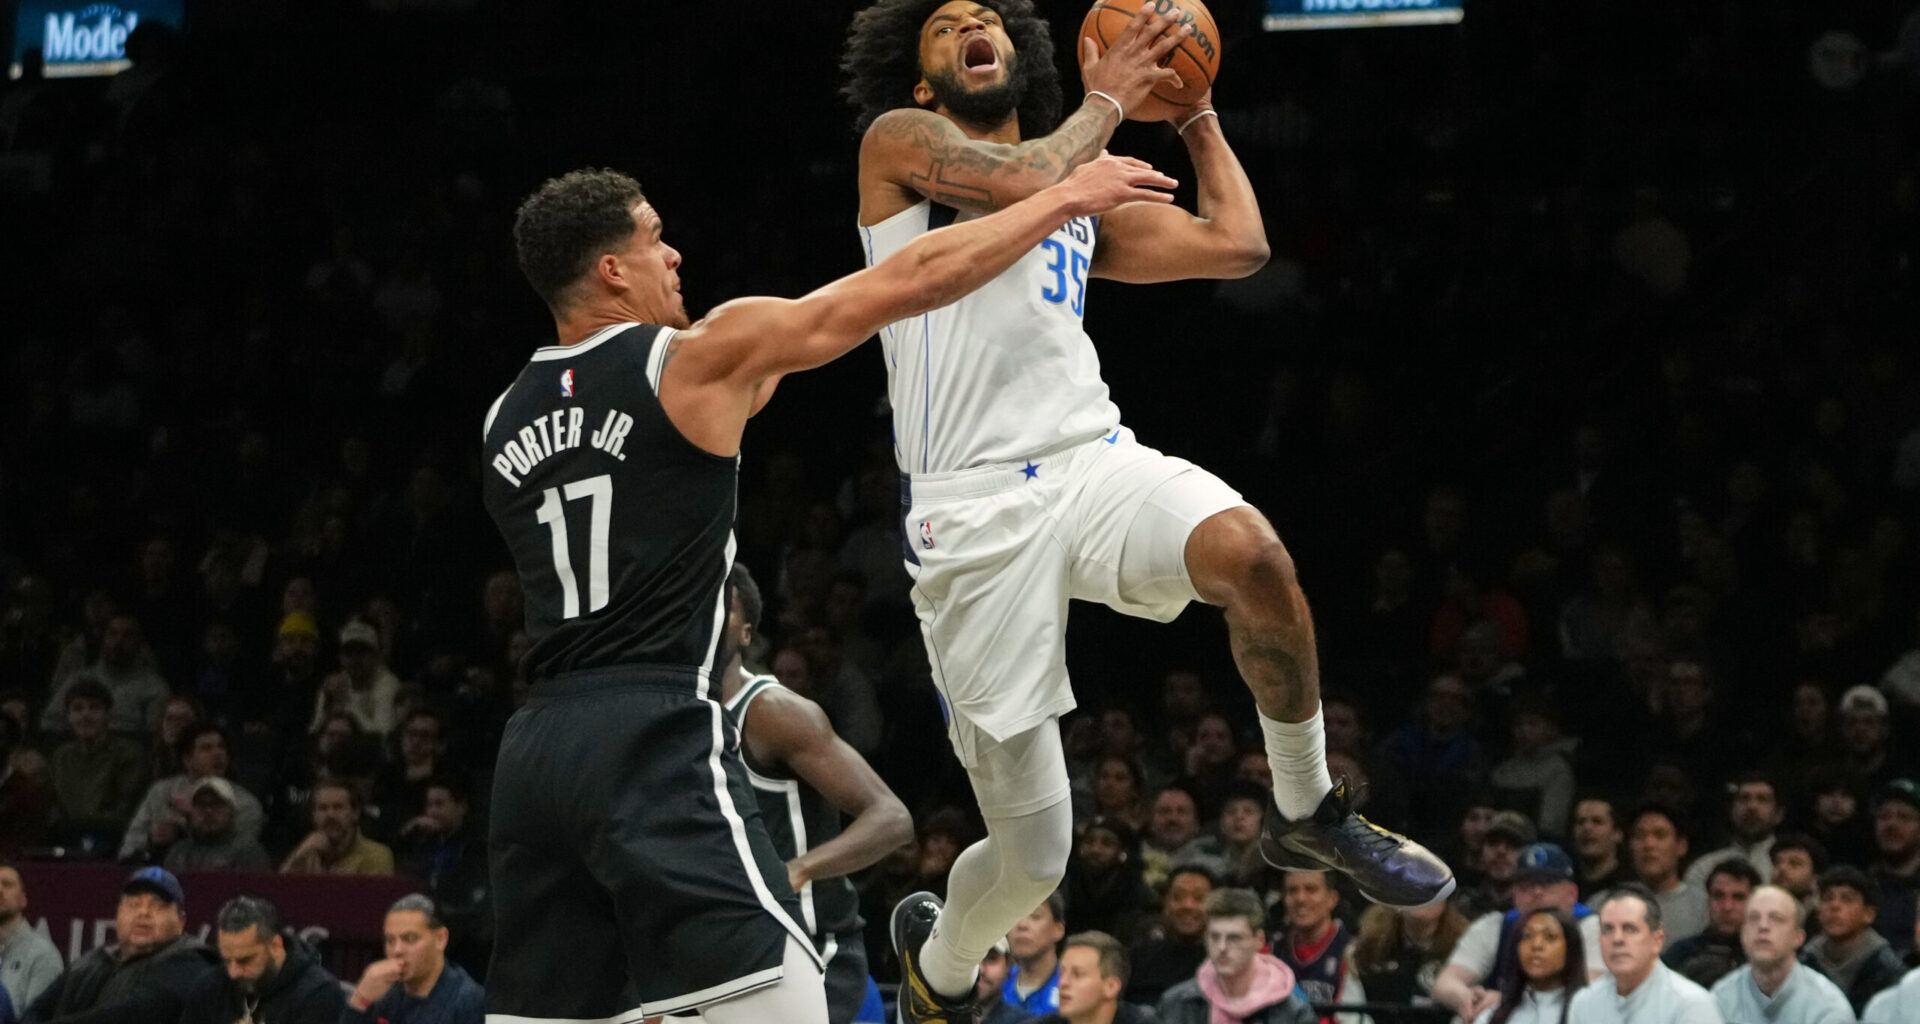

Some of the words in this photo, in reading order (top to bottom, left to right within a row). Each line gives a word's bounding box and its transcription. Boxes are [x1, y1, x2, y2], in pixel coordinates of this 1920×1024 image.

[43, 11, 138, 59] Mode
[1041, 238, 1088, 317] 35
[492, 406, 584, 488] PORTER
[590, 408, 634, 462] JR.
[536, 474, 613, 619] 17
